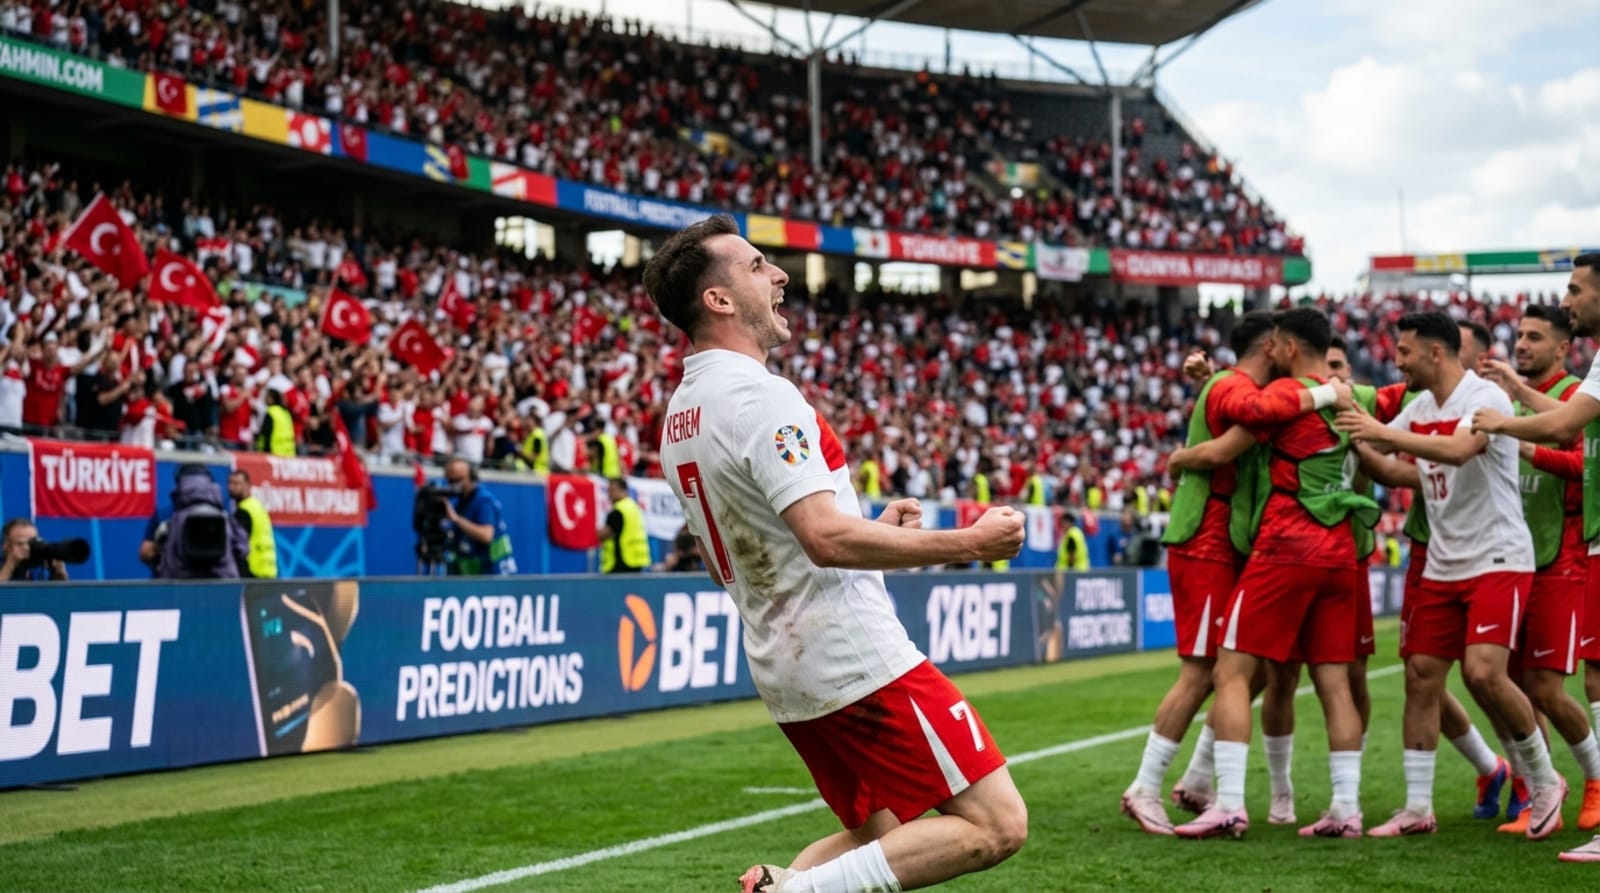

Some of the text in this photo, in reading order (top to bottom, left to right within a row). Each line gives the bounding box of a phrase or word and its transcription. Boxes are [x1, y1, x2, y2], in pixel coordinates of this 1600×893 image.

[0, 42, 103, 93] AHMIN.COM
[666, 406, 701, 445] KEREM
[41, 448, 151, 493] TÜRKİYE
[1428, 472, 1448, 500] 13
[676, 462, 736, 584] 7
[421, 594, 565, 652] FOOTBALL
[658, 592, 740, 692] BET
[926, 582, 1017, 663] 1XBET
[0, 609, 181, 762] BET
[396, 652, 584, 721] PREDICTIONS
[948, 700, 985, 752] 7
